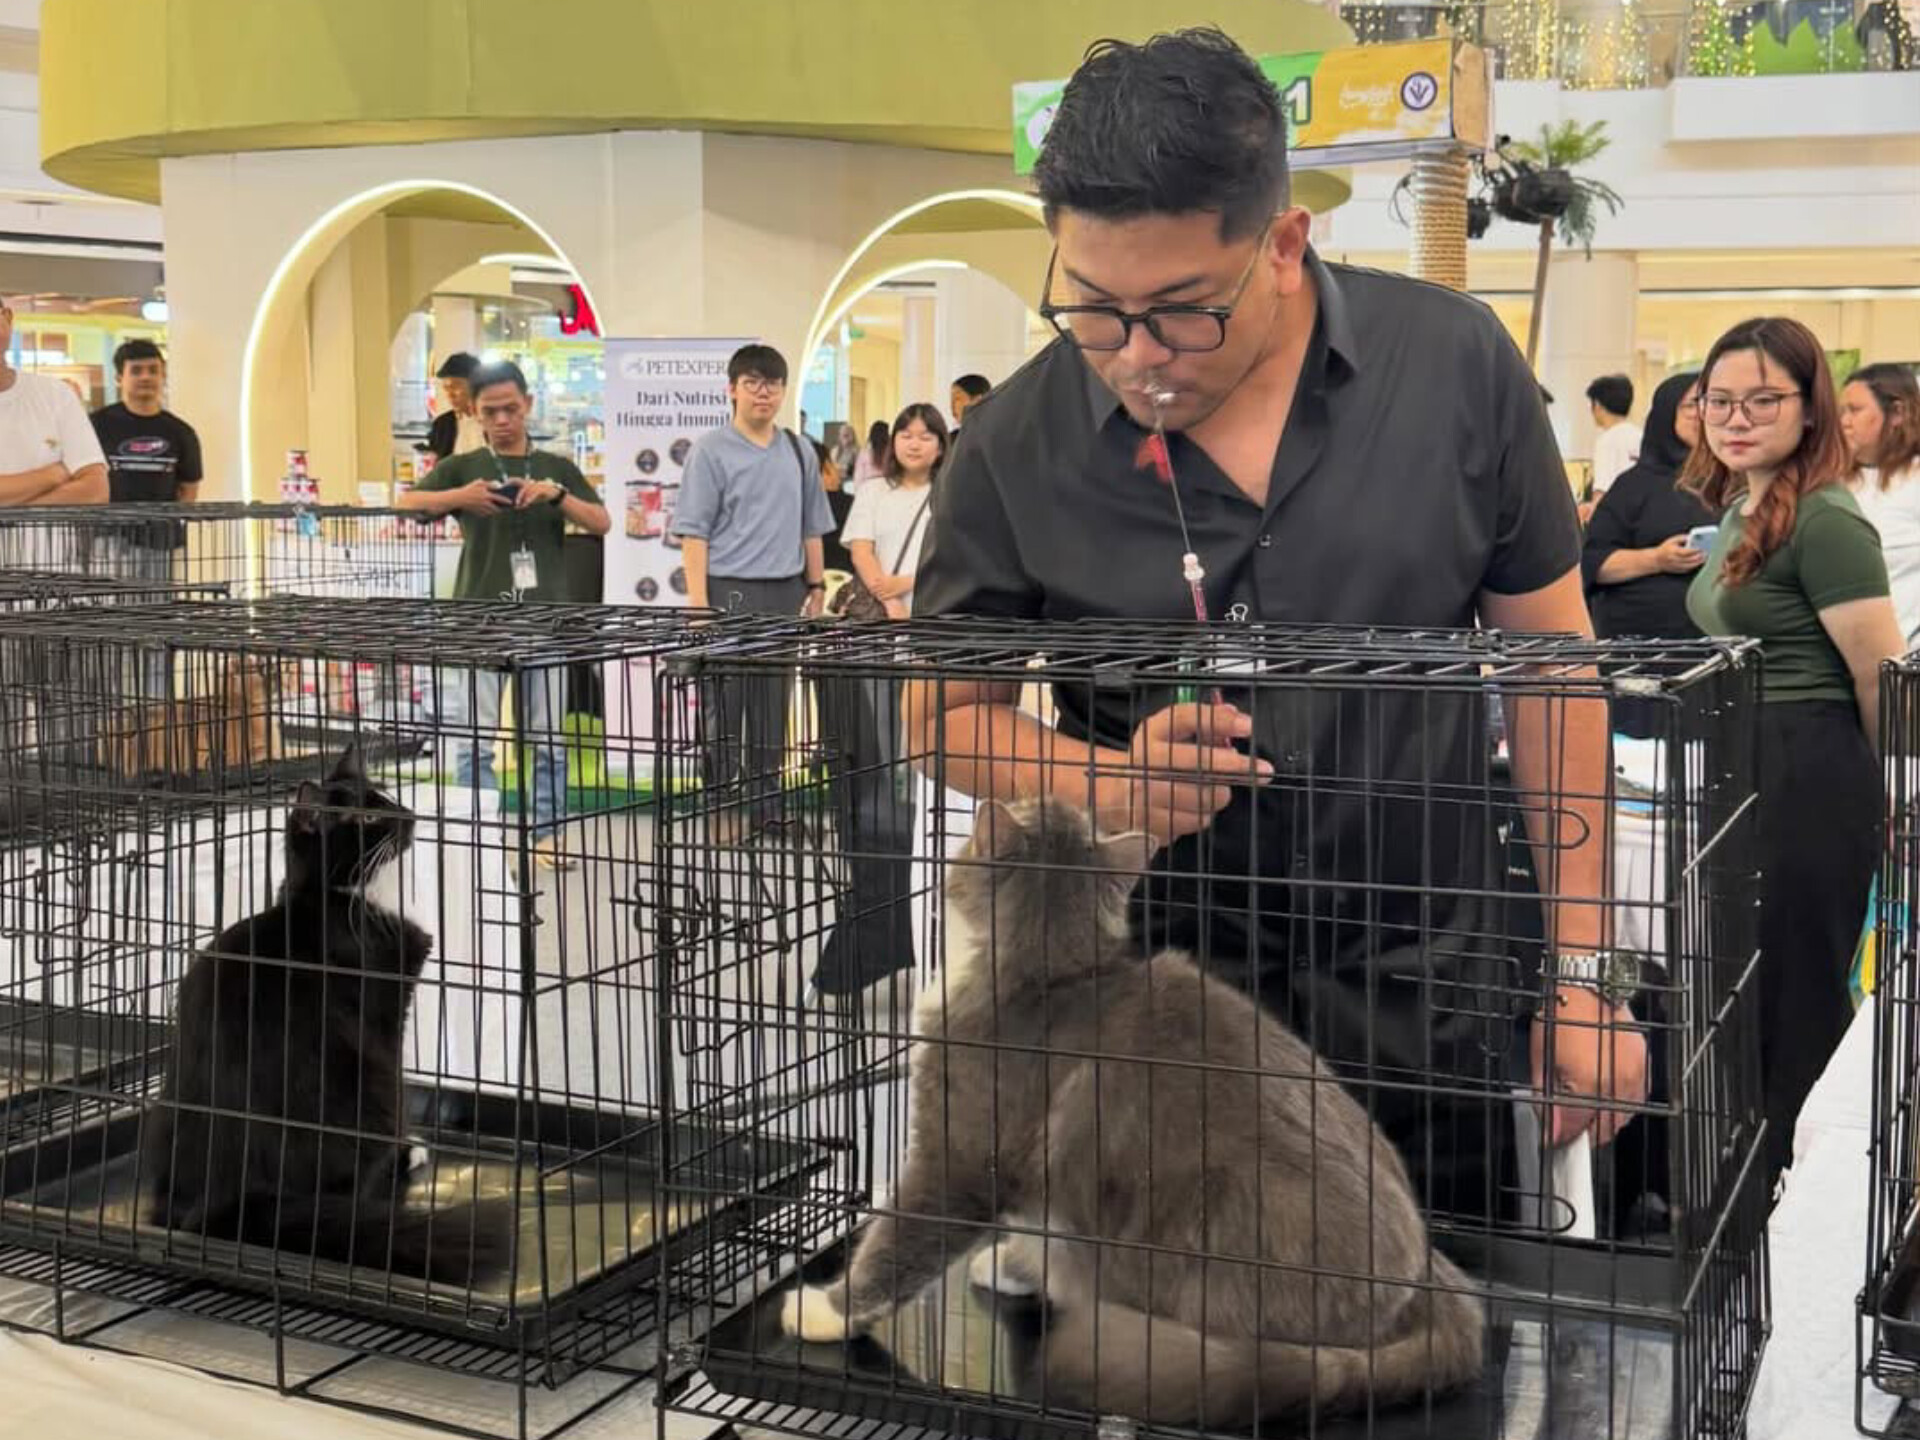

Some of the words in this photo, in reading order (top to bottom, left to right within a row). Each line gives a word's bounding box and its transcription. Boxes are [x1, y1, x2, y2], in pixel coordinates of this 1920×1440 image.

[646, 359, 728, 376] PETEXPER
[637, 390, 670, 406] Dari
[673, 390, 727, 406] Nutrisi
[617, 410, 672, 427] Hingga
